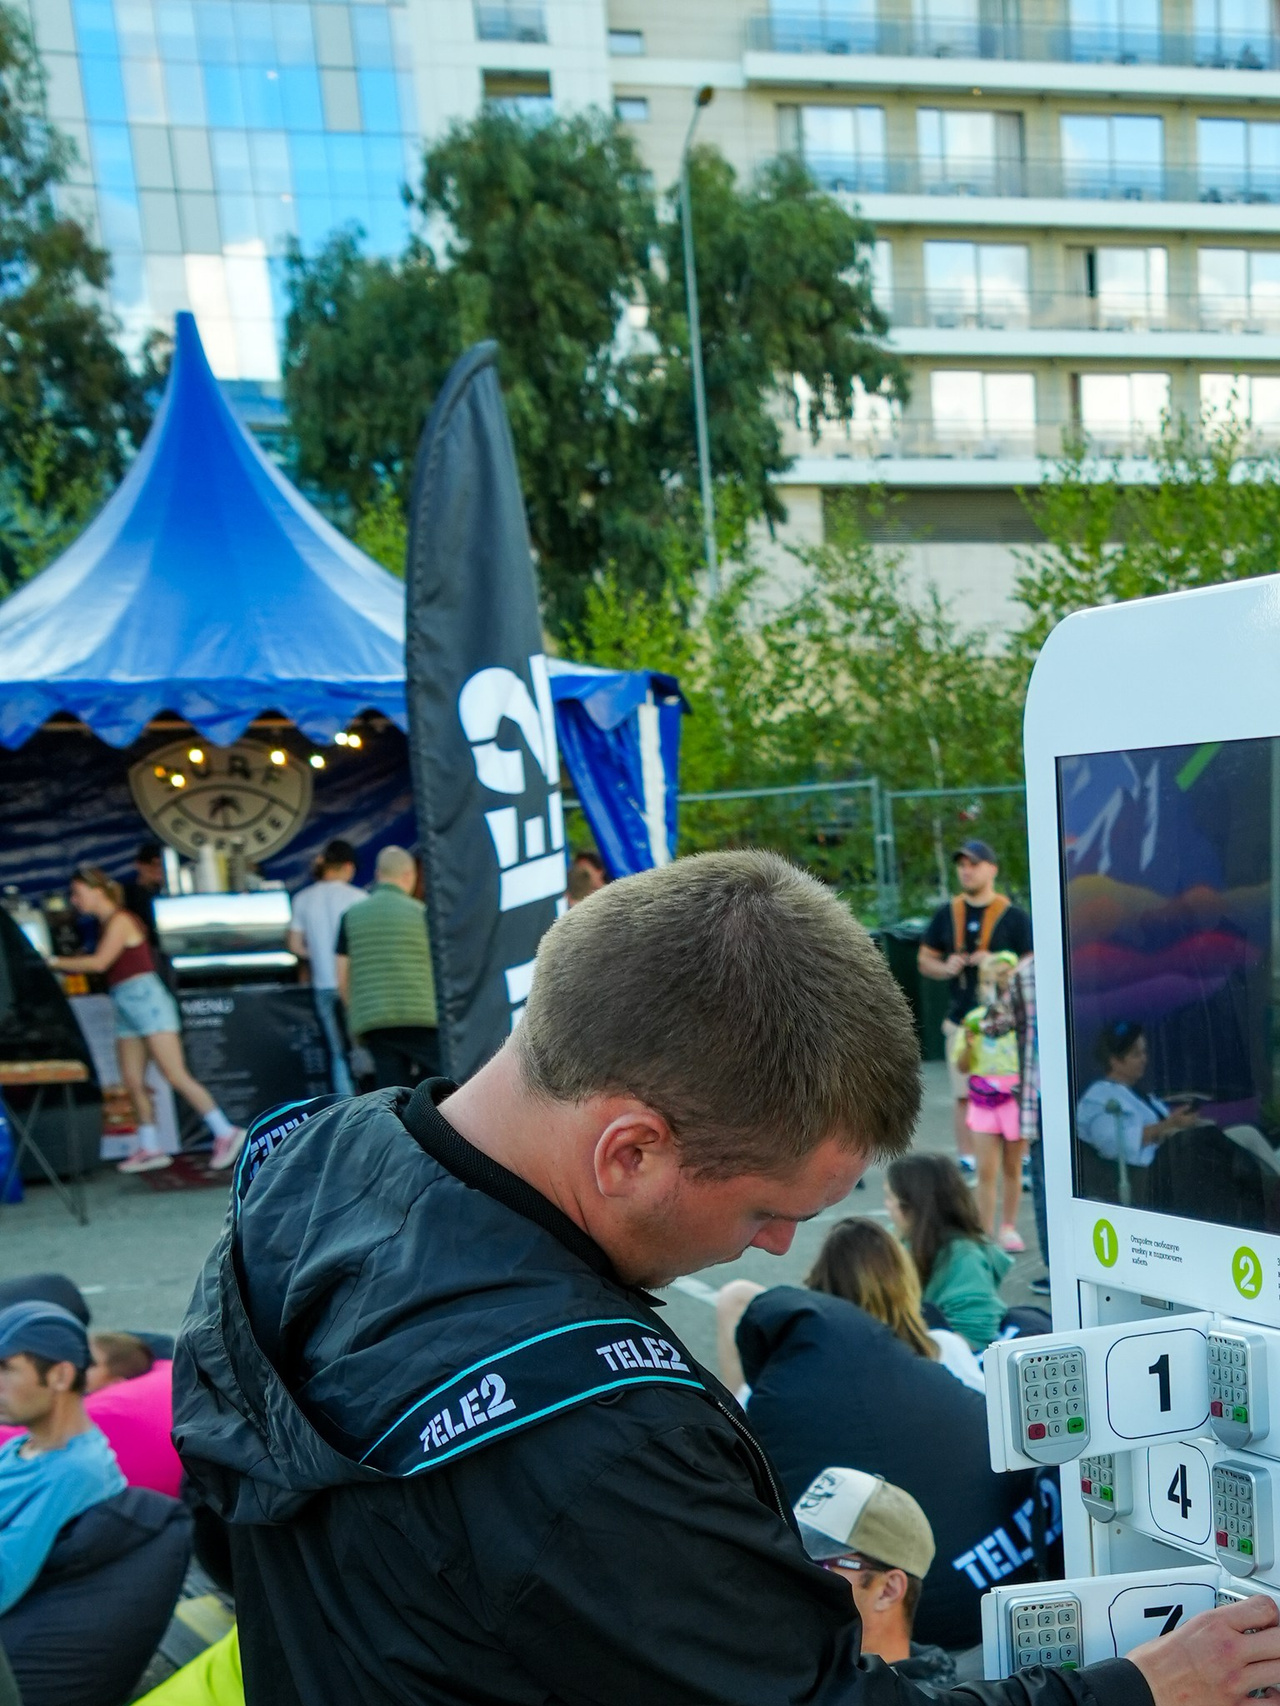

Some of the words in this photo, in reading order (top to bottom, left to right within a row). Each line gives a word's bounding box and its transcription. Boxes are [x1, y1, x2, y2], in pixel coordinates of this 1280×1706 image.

[1100, 1227, 1109, 1260] 1
[1239, 1255, 1255, 1292] 2
[596, 1335, 690, 1373] TELE2
[1053, 1387, 1057, 1395] 5
[1148, 1354, 1171, 1412] 1
[419, 1373, 517, 1453] TELE2
[1034, 1409, 1039, 1417] 7
[1073, 1403, 1078, 1411] 9
[1055, 1425, 1059, 1433] 0
[1167, 1464, 1192, 1519] 4
